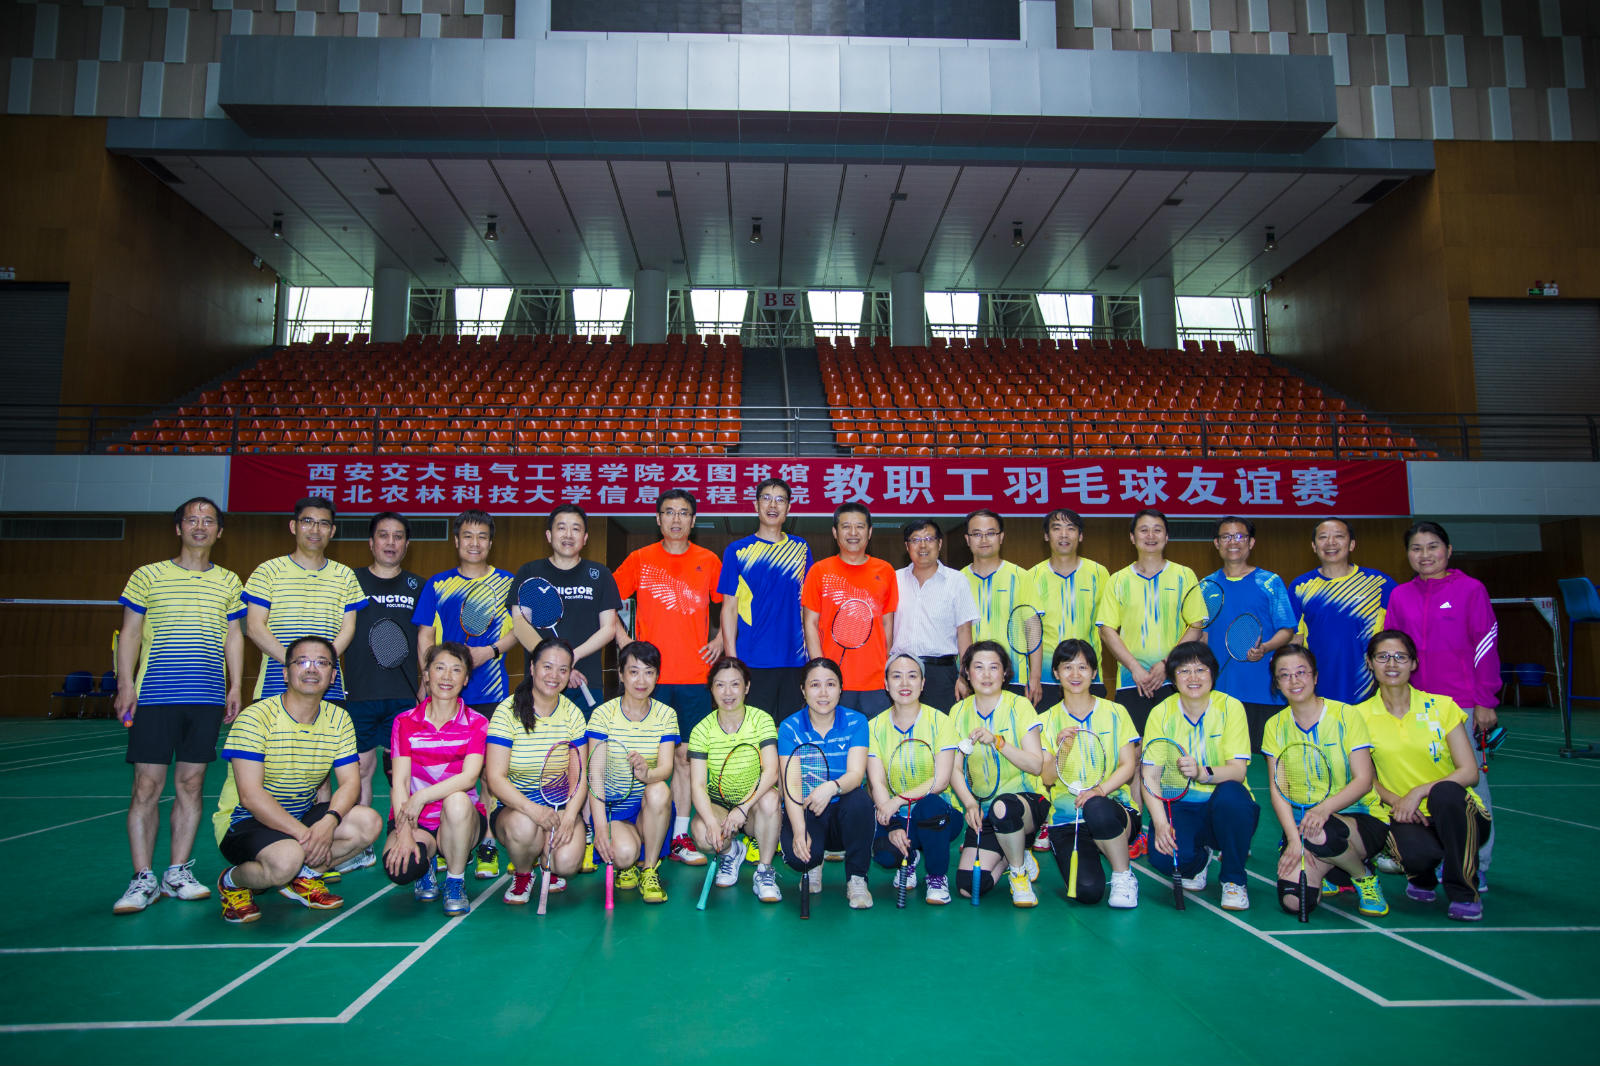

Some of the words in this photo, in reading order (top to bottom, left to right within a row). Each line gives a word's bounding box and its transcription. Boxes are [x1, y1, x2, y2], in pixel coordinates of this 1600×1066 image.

[307, 463, 810, 482] 西安交大电气工程学院及图书馆
[823, 463, 1339, 507] 教职工羽毛球友谊赛
[371, 594, 415, 606] VICTOR
